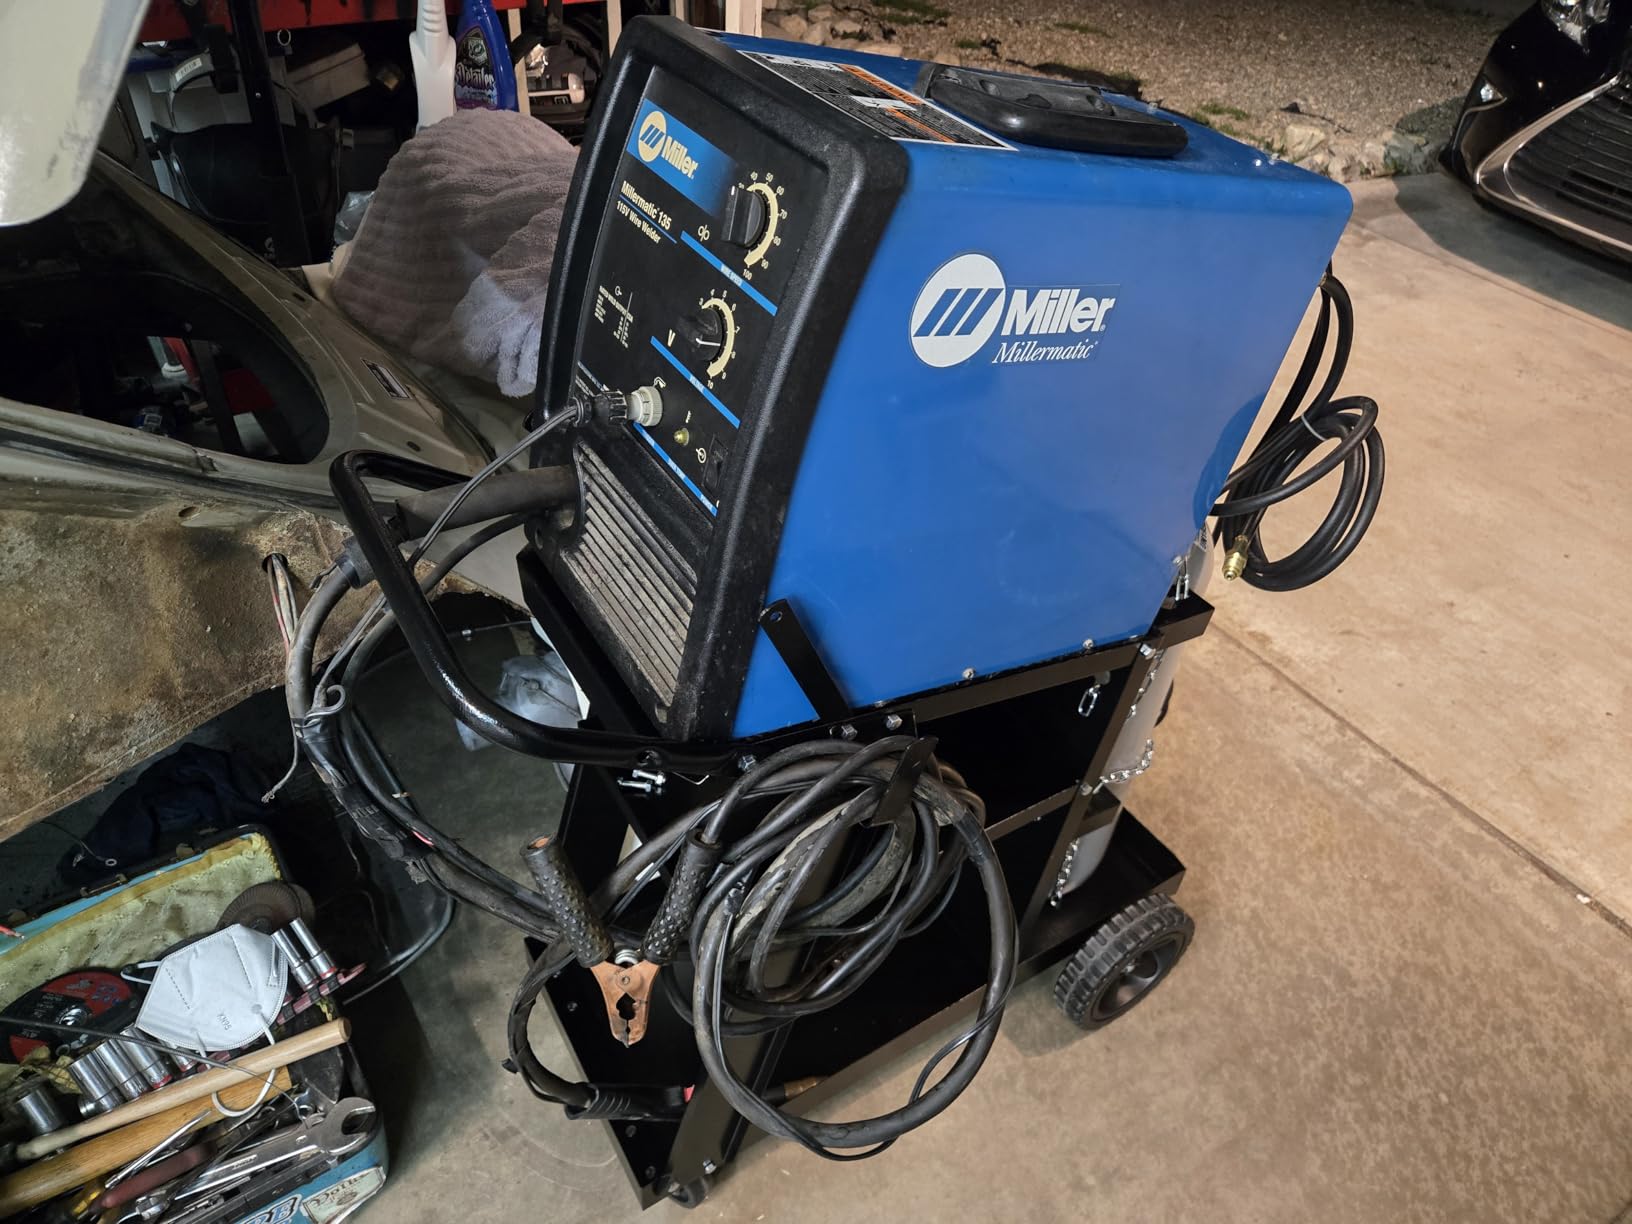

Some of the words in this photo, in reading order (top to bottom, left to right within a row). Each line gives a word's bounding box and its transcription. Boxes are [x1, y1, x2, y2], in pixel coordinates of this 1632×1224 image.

[661, 136, 698, 178] Miller
[616, 200, 631, 217] 115V
[629, 210, 642, 228] Wire
[641, 220, 661, 244] Welder
[658, 211, 673, 230] 135
[780, 208, 788, 220] 70
[742, 268, 753, 281] 100
[1000, 288, 1116, 336] Miller
[735, 325, 741, 334] 7
[992, 338, 1096, 364] Millermatic
[707, 379, 714, 389] 10
